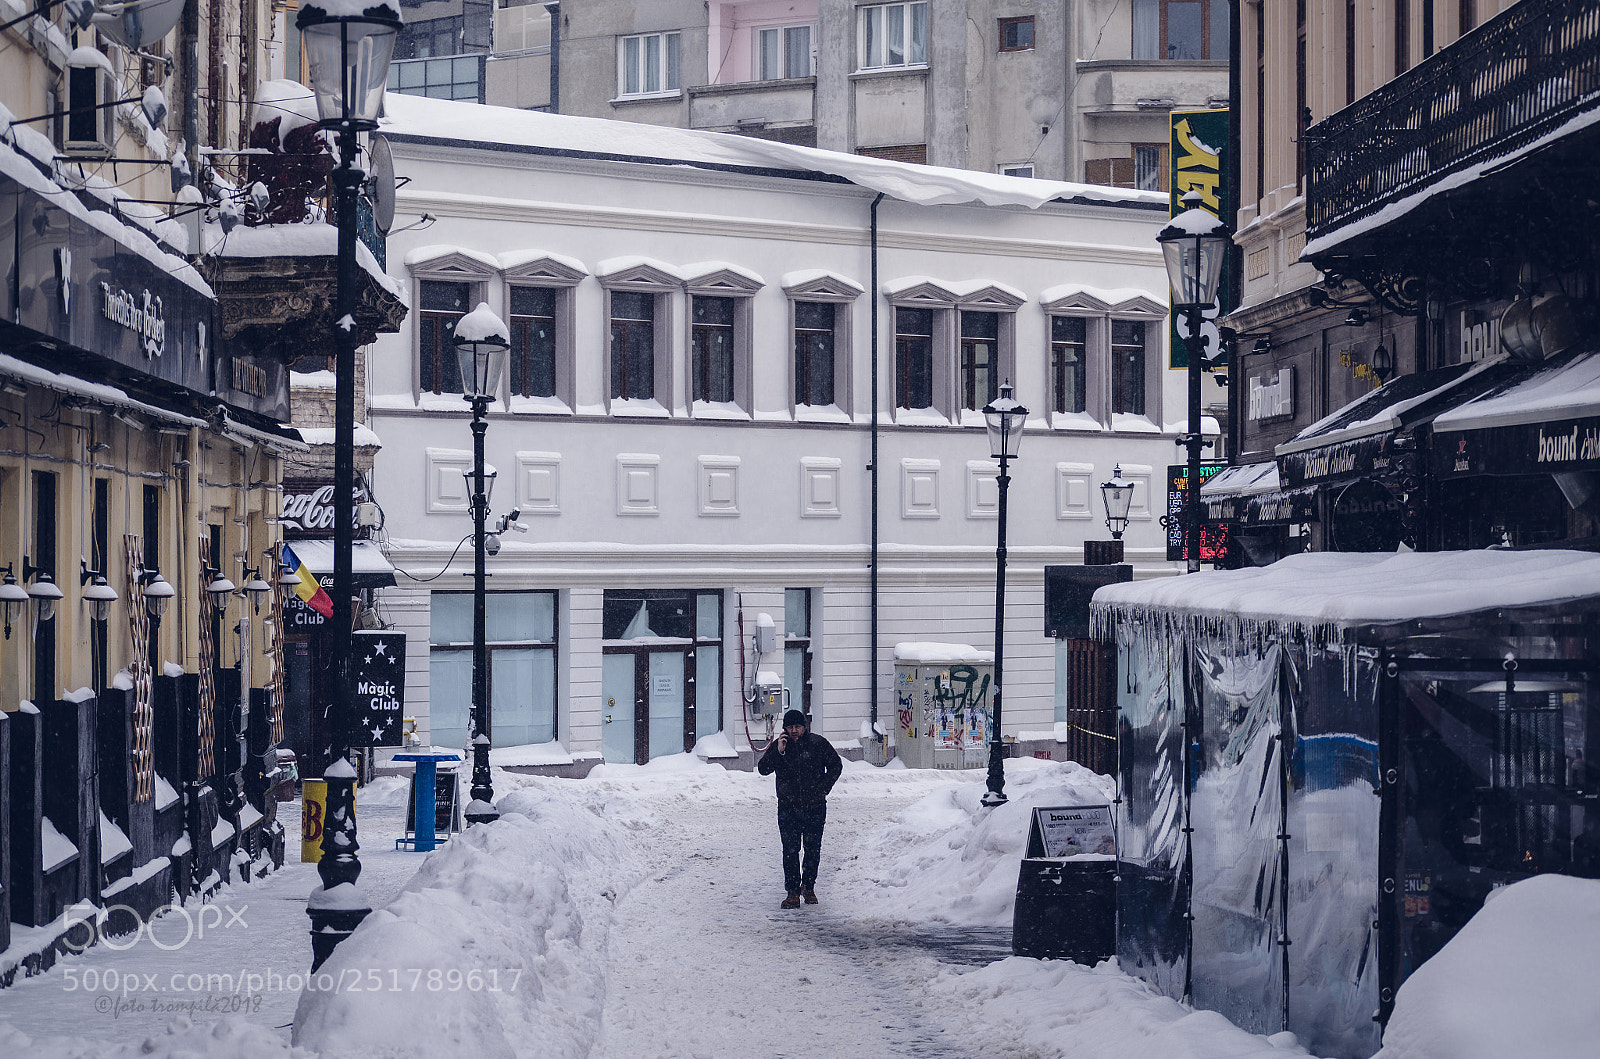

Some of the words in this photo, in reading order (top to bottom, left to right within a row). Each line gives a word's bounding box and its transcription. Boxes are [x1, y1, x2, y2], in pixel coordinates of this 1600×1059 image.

[1460, 310, 1501, 363] bou
[1538, 425, 1578, 463] bound
[1304, 448, 1330, 480] bound
[1169, 539, 1182, 547] TRY
[295, 612, 325, 625] Club
[357, 680, 396, 697] Magic
[370, 697, 400, 711] Club
[1049, 812, 1083, 822] bound
